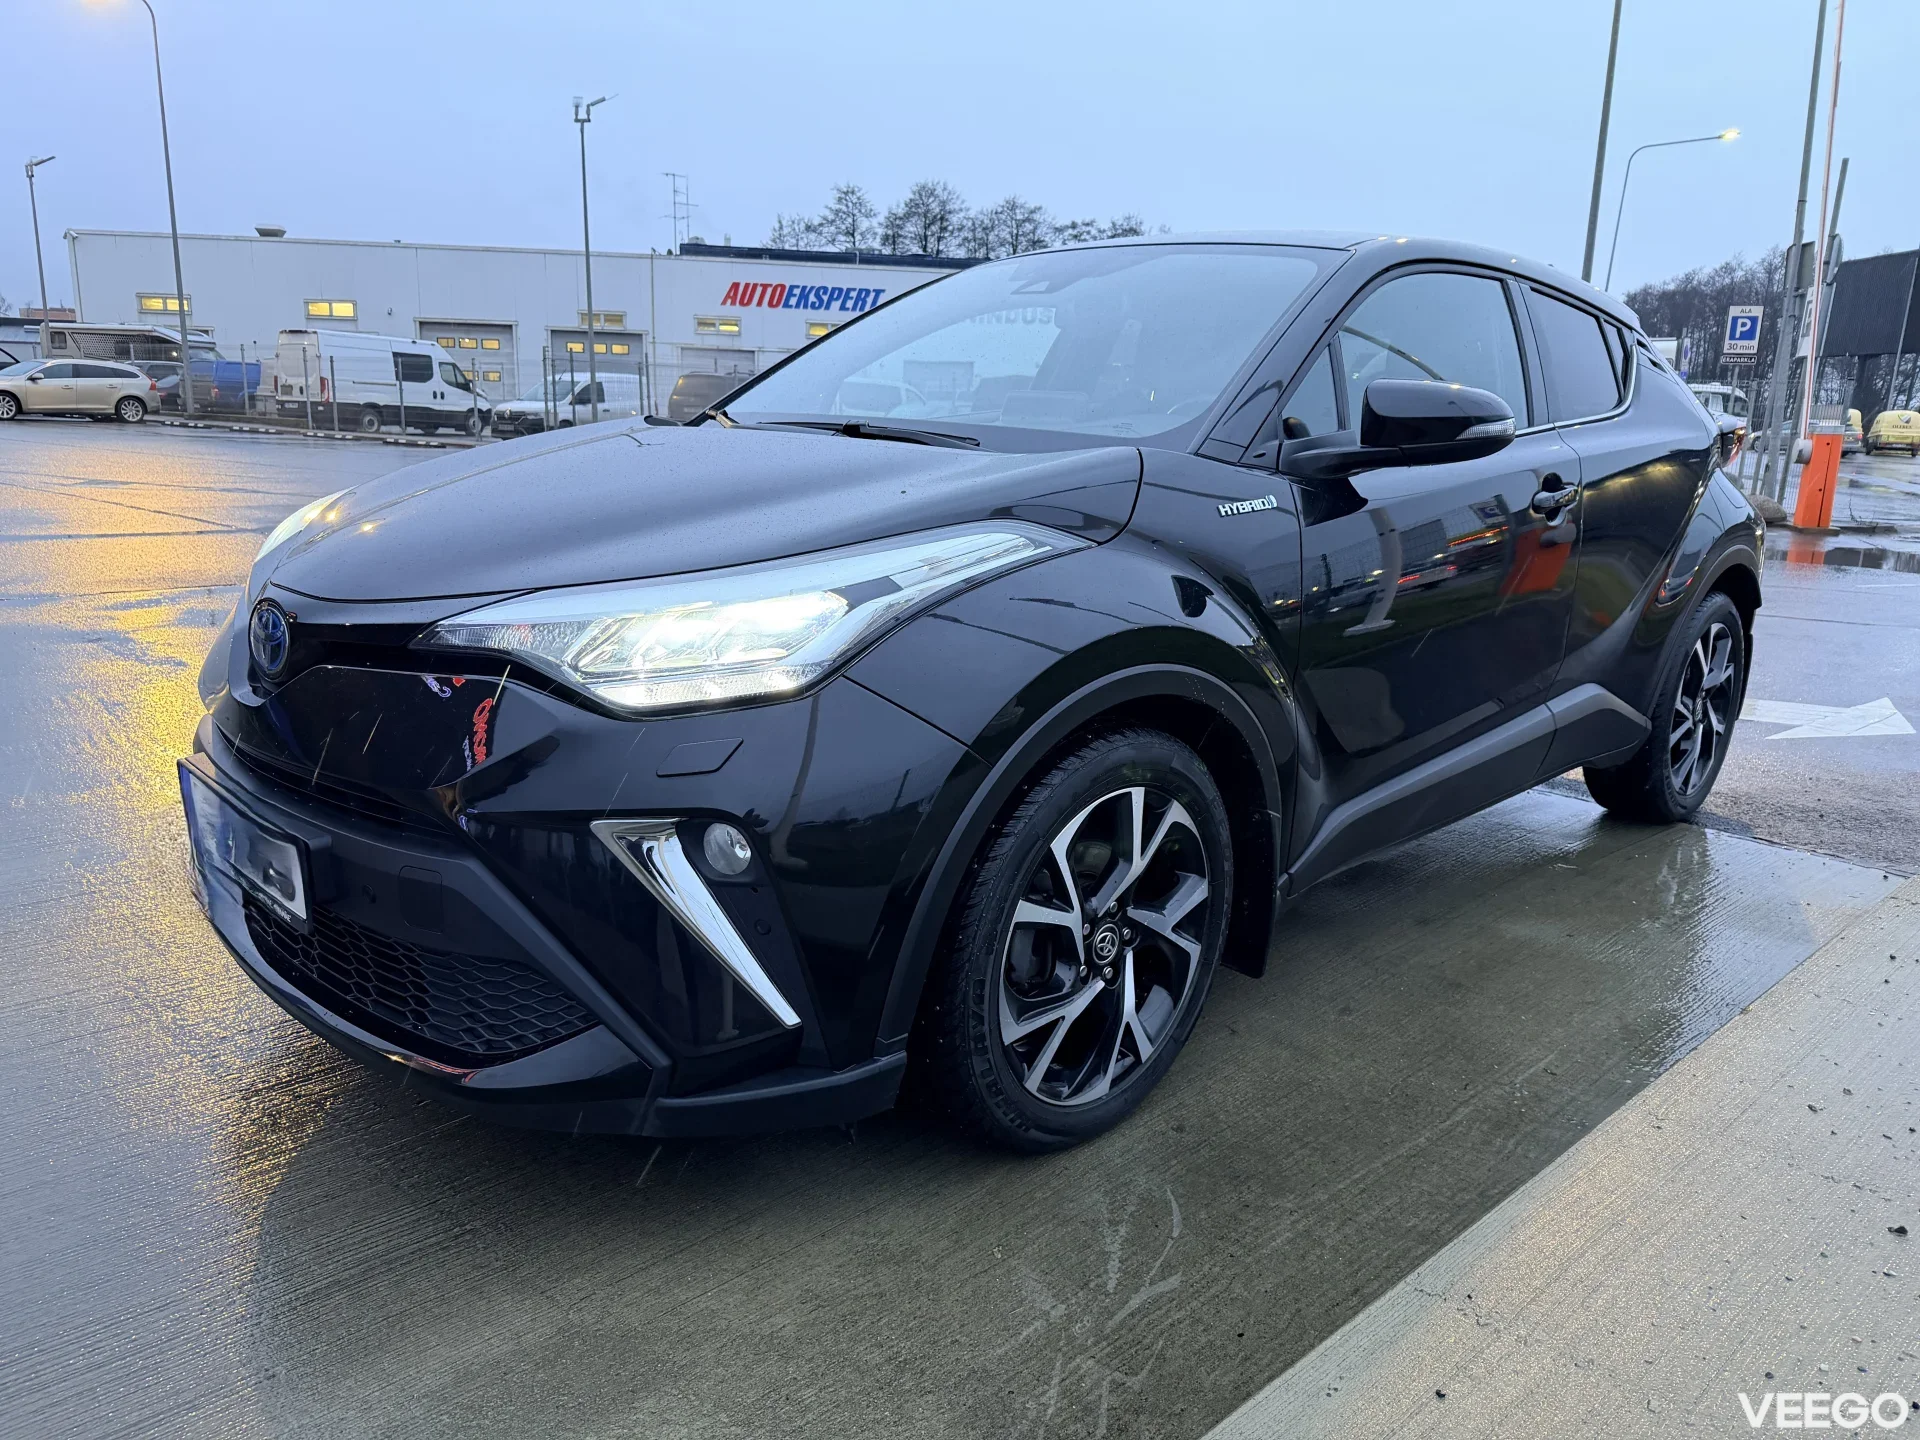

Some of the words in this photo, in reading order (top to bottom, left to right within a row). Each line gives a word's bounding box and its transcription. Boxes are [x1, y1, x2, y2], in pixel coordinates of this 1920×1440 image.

[720, 281, 886, 313] AUTOEKSPERT
[1735, 318, 1751, 339] P
[1726, 343, 1738, 351] 30
[1739, 343, 1755, 351] min
[1218, 498, 1272, 516] HYBRID
